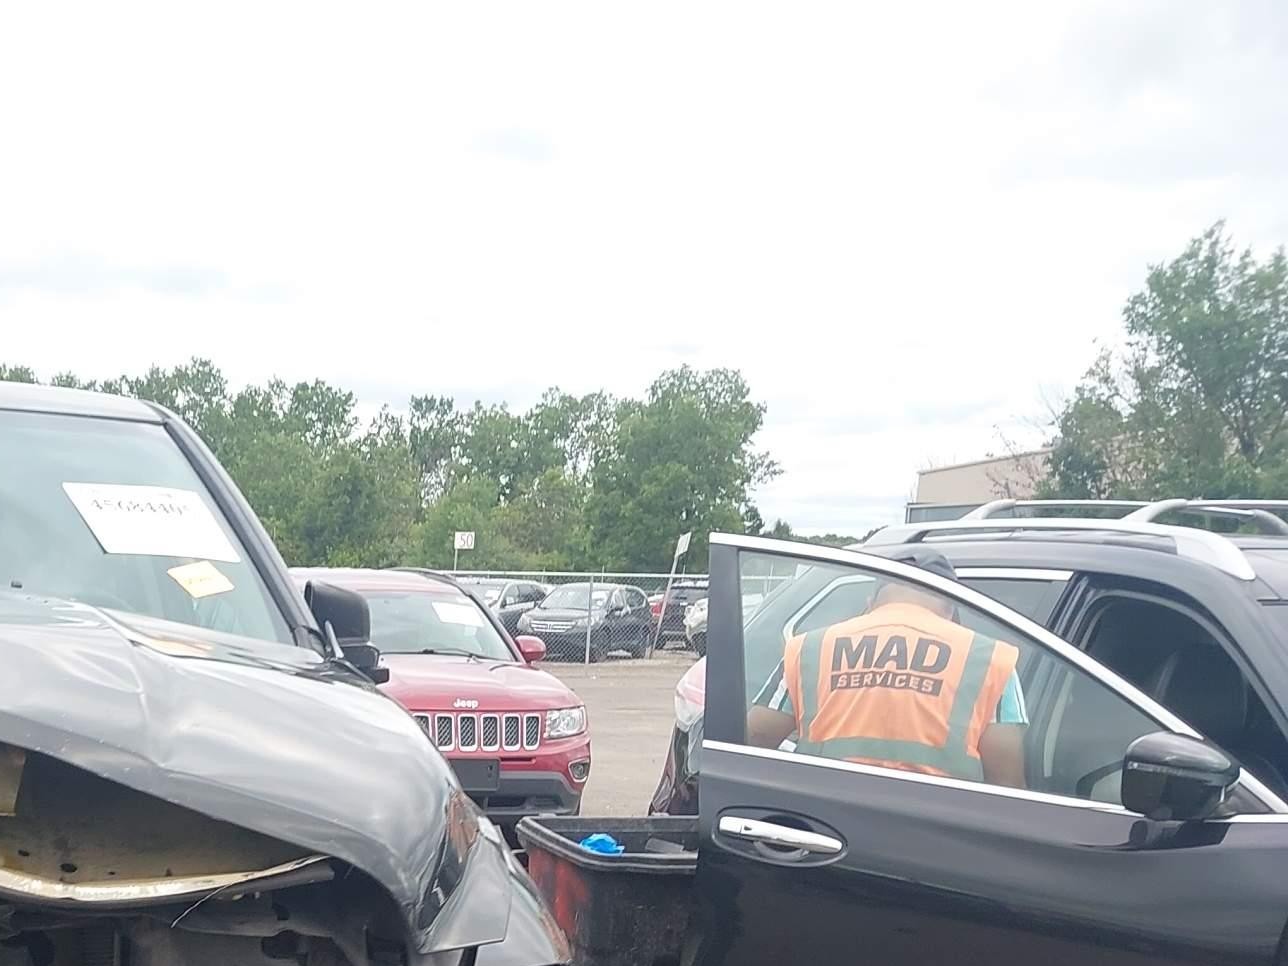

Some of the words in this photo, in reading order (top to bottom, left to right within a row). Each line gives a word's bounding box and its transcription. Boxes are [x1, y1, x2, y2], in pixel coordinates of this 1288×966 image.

[832, 635, 952, 674] MAD
[837, 671, 934, 692] SERVICES
[454, 698, 479, 709] Jeep
